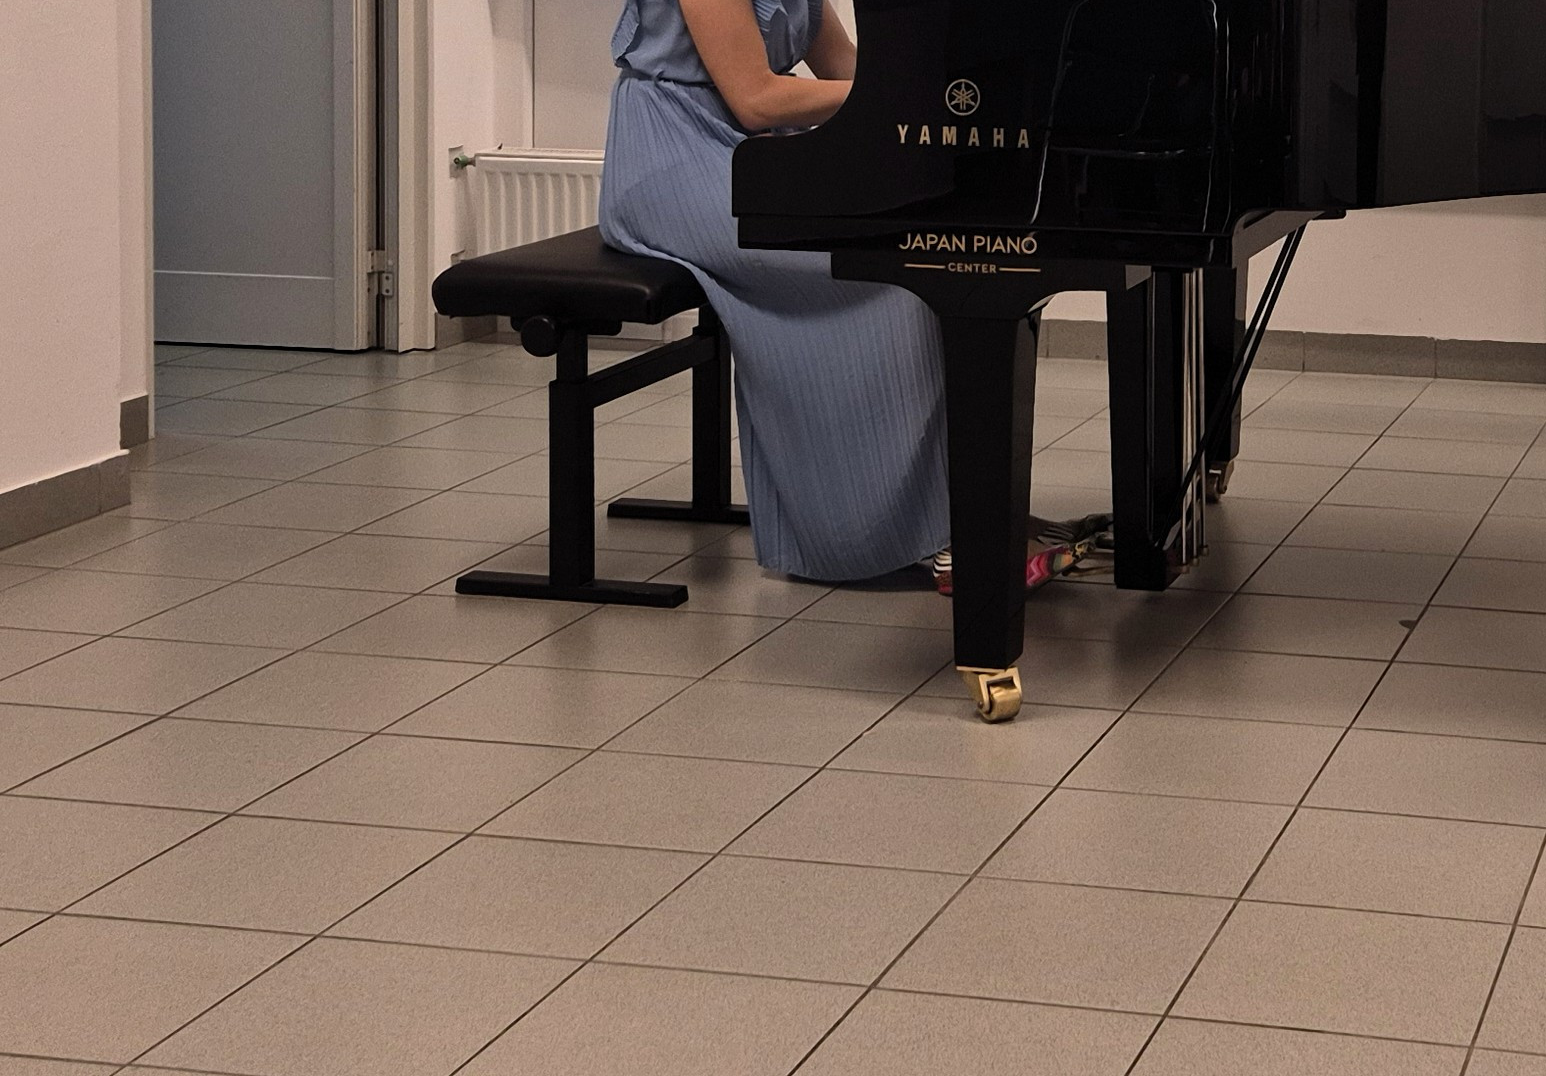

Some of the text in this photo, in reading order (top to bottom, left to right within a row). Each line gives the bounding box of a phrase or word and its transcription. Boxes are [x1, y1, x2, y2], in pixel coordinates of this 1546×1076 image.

[897, 124, 1030, 149] YAMAHA
[898, 232, 1038, 255] JAPAN PIANO
[947, 262, 997, 274] CENTER
